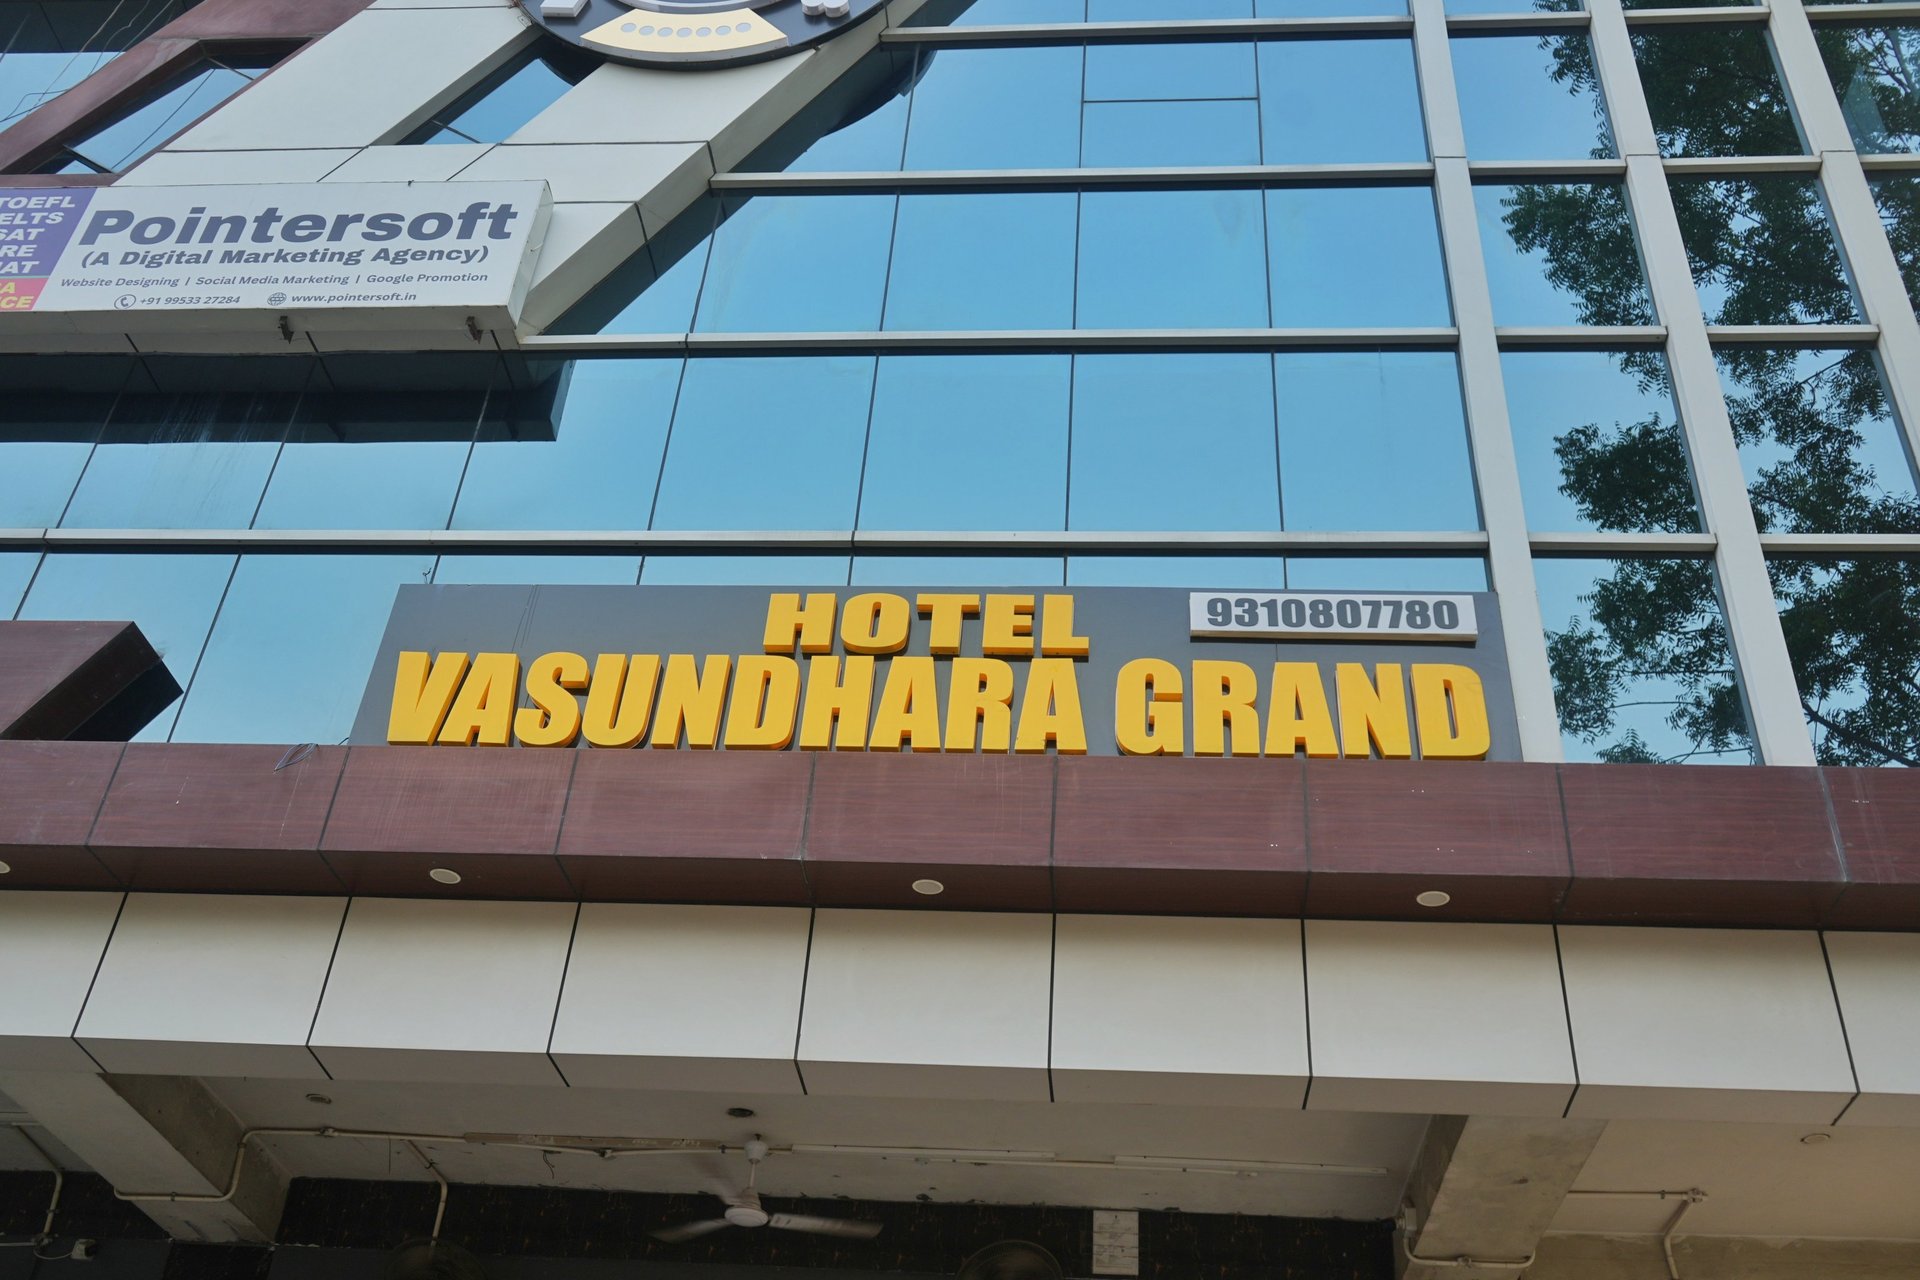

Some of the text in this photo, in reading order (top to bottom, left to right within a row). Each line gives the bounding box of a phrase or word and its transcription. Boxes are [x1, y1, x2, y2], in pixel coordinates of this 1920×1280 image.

[78, 202, 518, 246] Pointersoft
[81, 246, 489, 269] (A Digital Marketing Agency)
[61, 277, 112, 287] Website
[115, 277, 180, 289] Designing
[195, 276, 236, 286] Social
[238, 275, 279, 285] Media
[282, 275, 350, 286] Marketing
[366, 274, 414, 286] Google
[416, 273, 488, 283] Promotion
[140, 296, 241, 306] +91 99533 27284
[291, 292, 417, 303] www.pointersoft.in
[763, 594, 1089, 655] HOTEL
[1207, 597, 1459, 630] 9310807780
[388, 652, 1491, 761] VASUNDHARA GRAND
